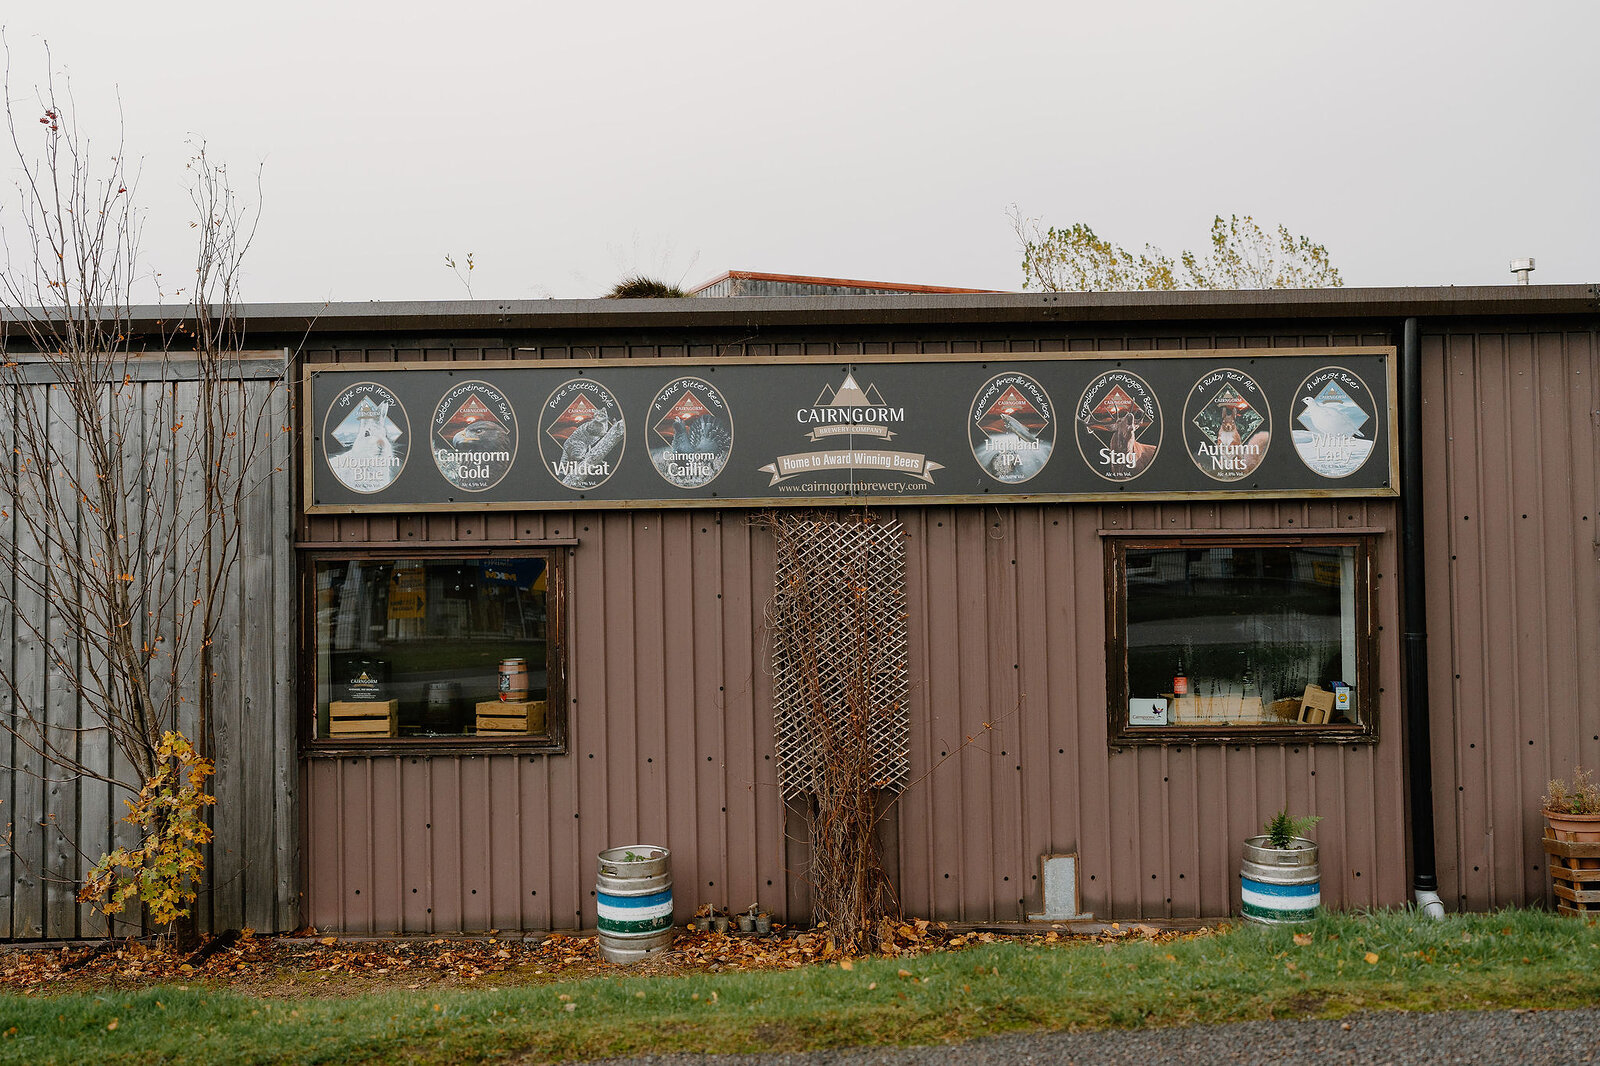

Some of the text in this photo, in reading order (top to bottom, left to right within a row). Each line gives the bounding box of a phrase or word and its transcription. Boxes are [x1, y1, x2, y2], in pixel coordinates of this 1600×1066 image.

[1203, 373, 1224, 386] Ruby
[1227, 372, 1245, 381] Red
[1244, 380, 1255, 392] Ale
[1341, 374, 1359, 389] Beer
[340, 385, 396, 407] Light and Hoppy
[550, 383, 614, 409] Pure Scottish Style
[682, 380, 708, 391] Bitter
[707, 390, 722, 408] Beer
[1081, 374, 1154, 419] Traditional Mahogany Bitter
[436, 384, 510, 424] Golden Continental Style
[797, 408, 904, 423] CAIRNGORM
[820, 426, 882, 434] BREWERY COMPANY
[984, 438, 1039, 453] Highland
[1312, 433, 1356, 447] White
[438, 449, 509, 464] Cairngorm
[663, 450, 715, 462] Cairngorm
[1198, 442, 1259, 456] Autumn
[1316, 447, 1352, 464] Lady
[337, 456, 399, 468] Mountain
[784, 453, 919, 470] Home to Award Winning Beers
[1002, 454, 1023, 466] IPA
[1100, 448, 1136, 469] Stag
[1211, 456, 1247, 470] Nuts
[354, 468, 383, 481] Blue
[459, 465, 490, 478] Gold
[552, 461, 609, 475] Wildcat
[668, 462, 710, 476] Caillie
[778, 480, 927, 494] www.cairngormbrewery.com
